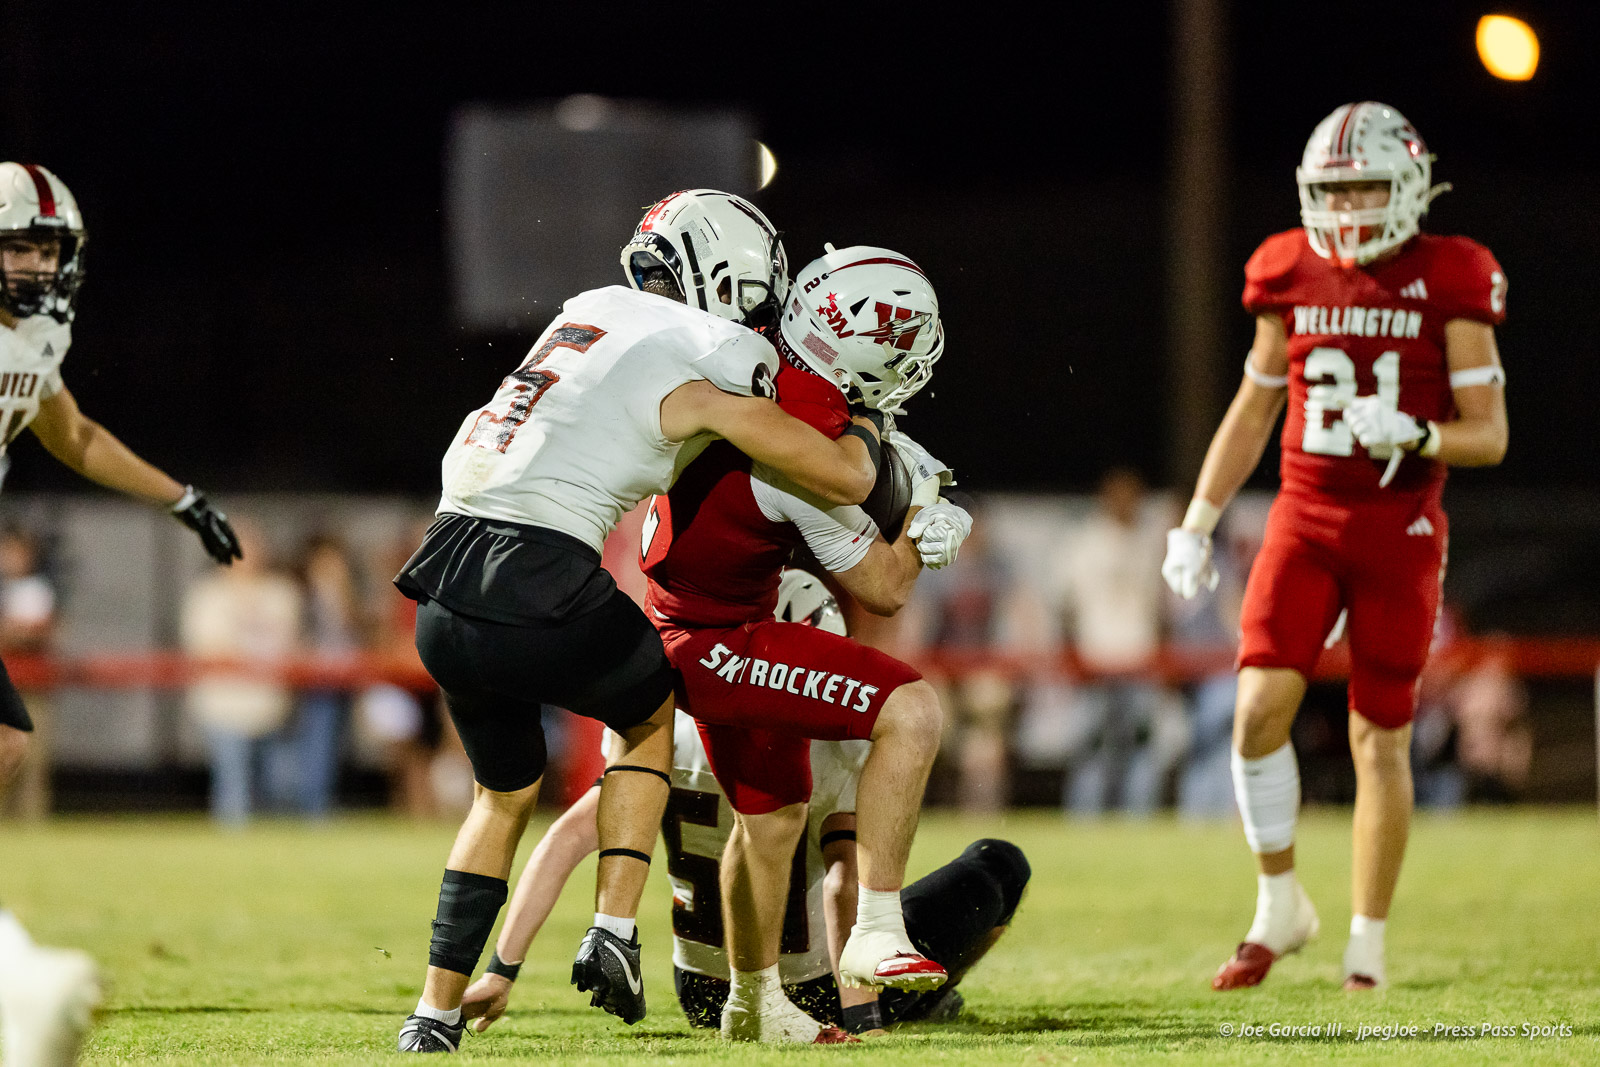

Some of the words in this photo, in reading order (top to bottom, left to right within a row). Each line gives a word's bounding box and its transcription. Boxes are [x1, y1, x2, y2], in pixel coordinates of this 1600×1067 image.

[1294, 306, 1422, 339] WELLINGTON
[464, 322, 608, 454] 5
[1302, 348, 1402, 459] 21
